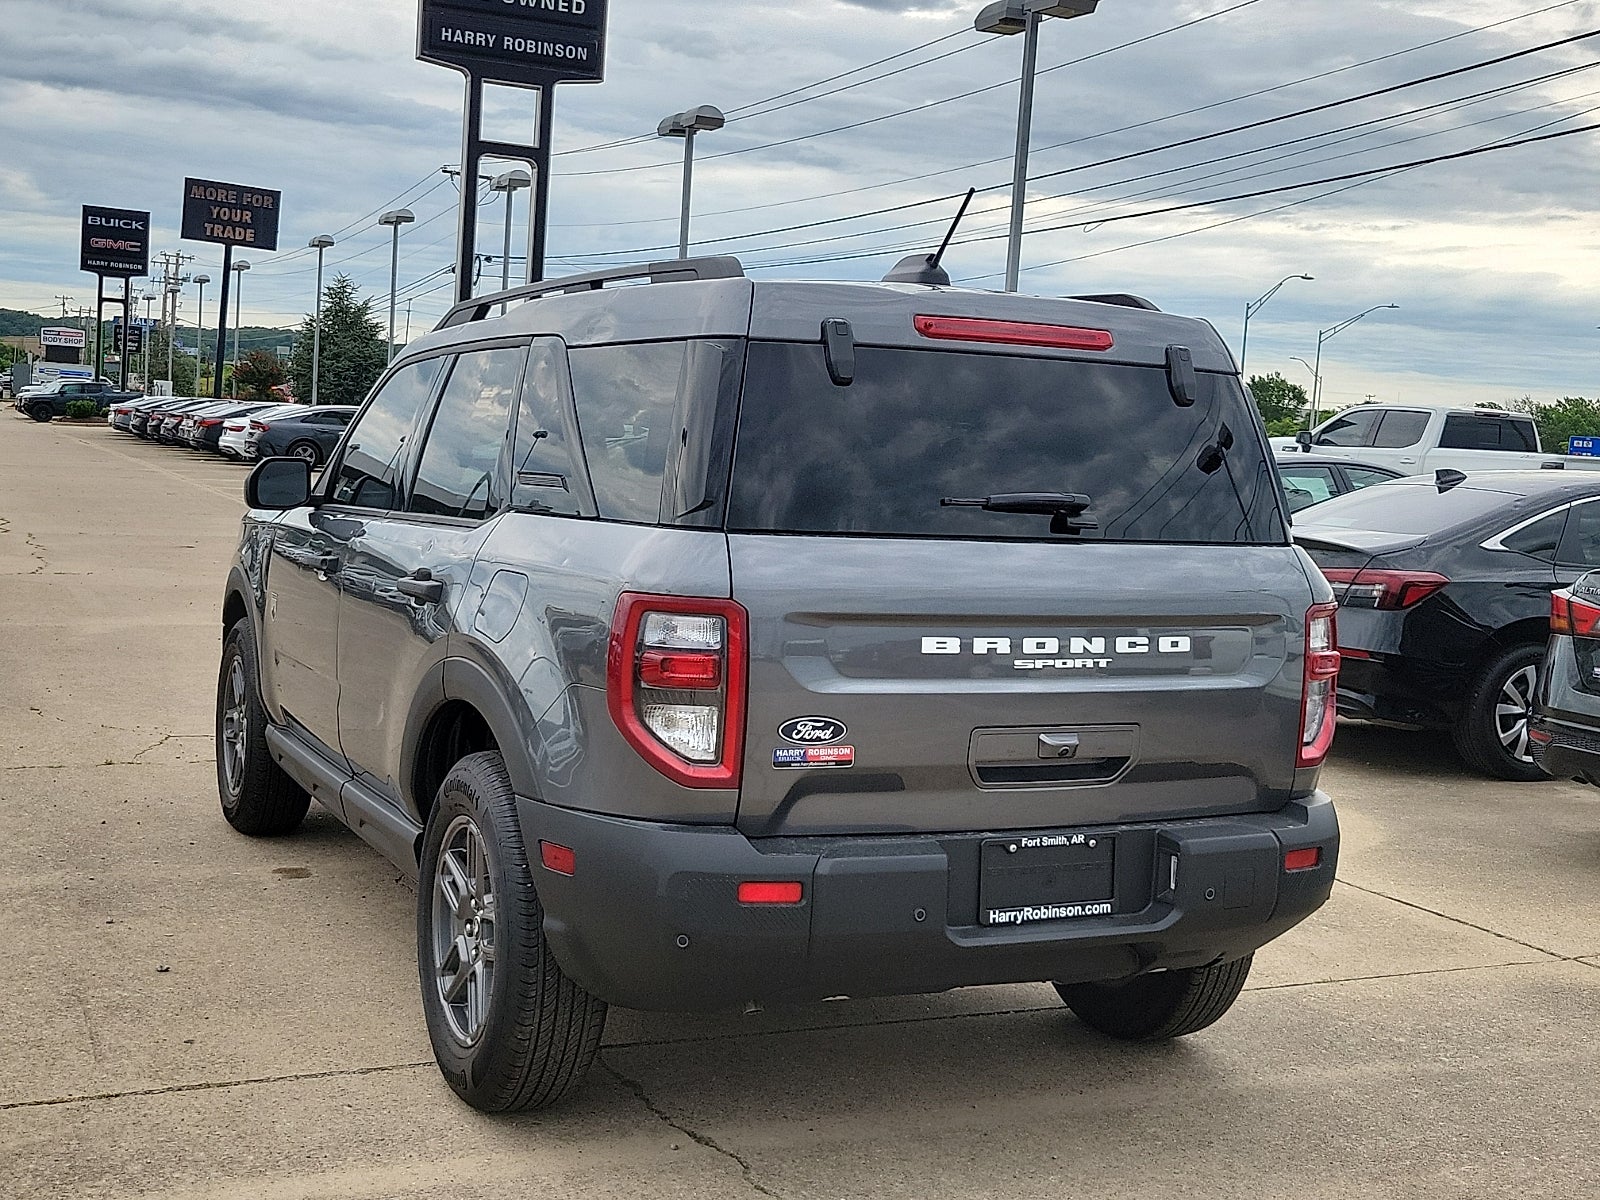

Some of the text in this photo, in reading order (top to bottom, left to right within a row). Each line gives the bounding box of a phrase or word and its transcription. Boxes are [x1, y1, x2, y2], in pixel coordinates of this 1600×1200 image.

[441, 27, 588, 60] HARRY ROBINSON
[190, 185, 274, 209] MORE FOR
[87, 215, 145, 231] BUICK
[210, 205, 252, 224] YOUR
[204, 222, 255, 242] TRADE
[90, 237, 142, 252] GMC
[87, 259, 143, 271] HARRY ROBINSON
[921, 636, 1191, 655] BRONCO
[1013, 658, 1113, 669] SPORT
[791, 720, 835, 740] Ford
[776, 747, 851, 757] HARRY ROBINSON
[1021, 834, 1086, 848] Fort Smith, AR
[989, 903, 1112, 924] HarryRobinson.com
